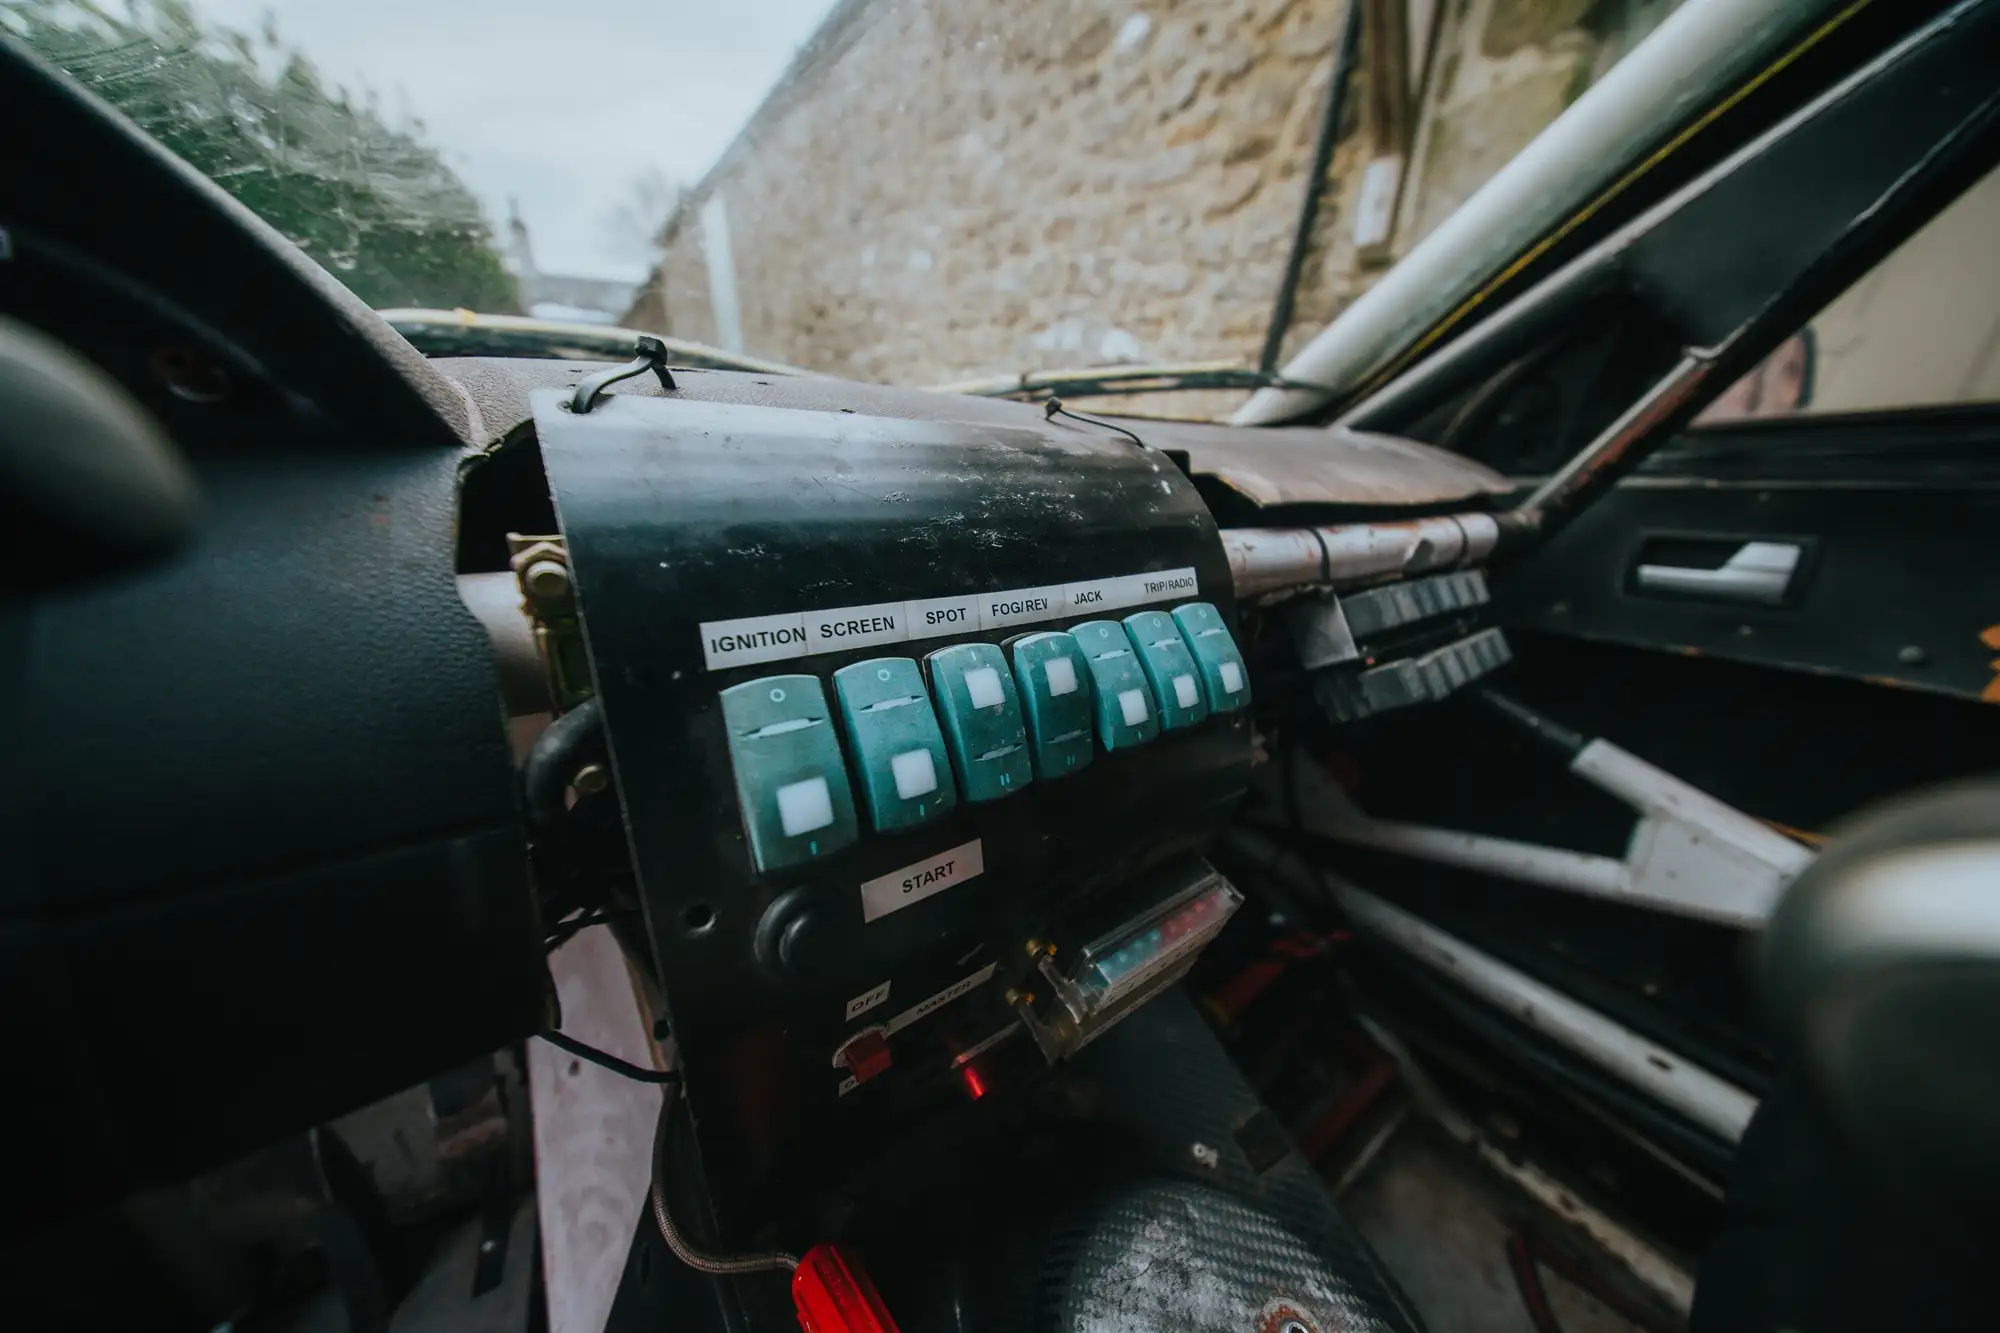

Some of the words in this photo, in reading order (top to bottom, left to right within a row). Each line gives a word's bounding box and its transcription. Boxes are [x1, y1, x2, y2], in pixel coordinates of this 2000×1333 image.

[711, 627, 807, 653] IGNITION
[820, 615, 895, 639] SCREEN
[925, 607, 967, 625] SPOT
[991, 597, 1048, 617] FOG/REV
[1074, 590, 1103, 605] JACK
[1144, 577, 1194, 594] TRIP/RADIO
[902, 860, 955, 893] START
[851, 990, 885, 1013] OFF
[916, 980, 972, 1014] MASTER
